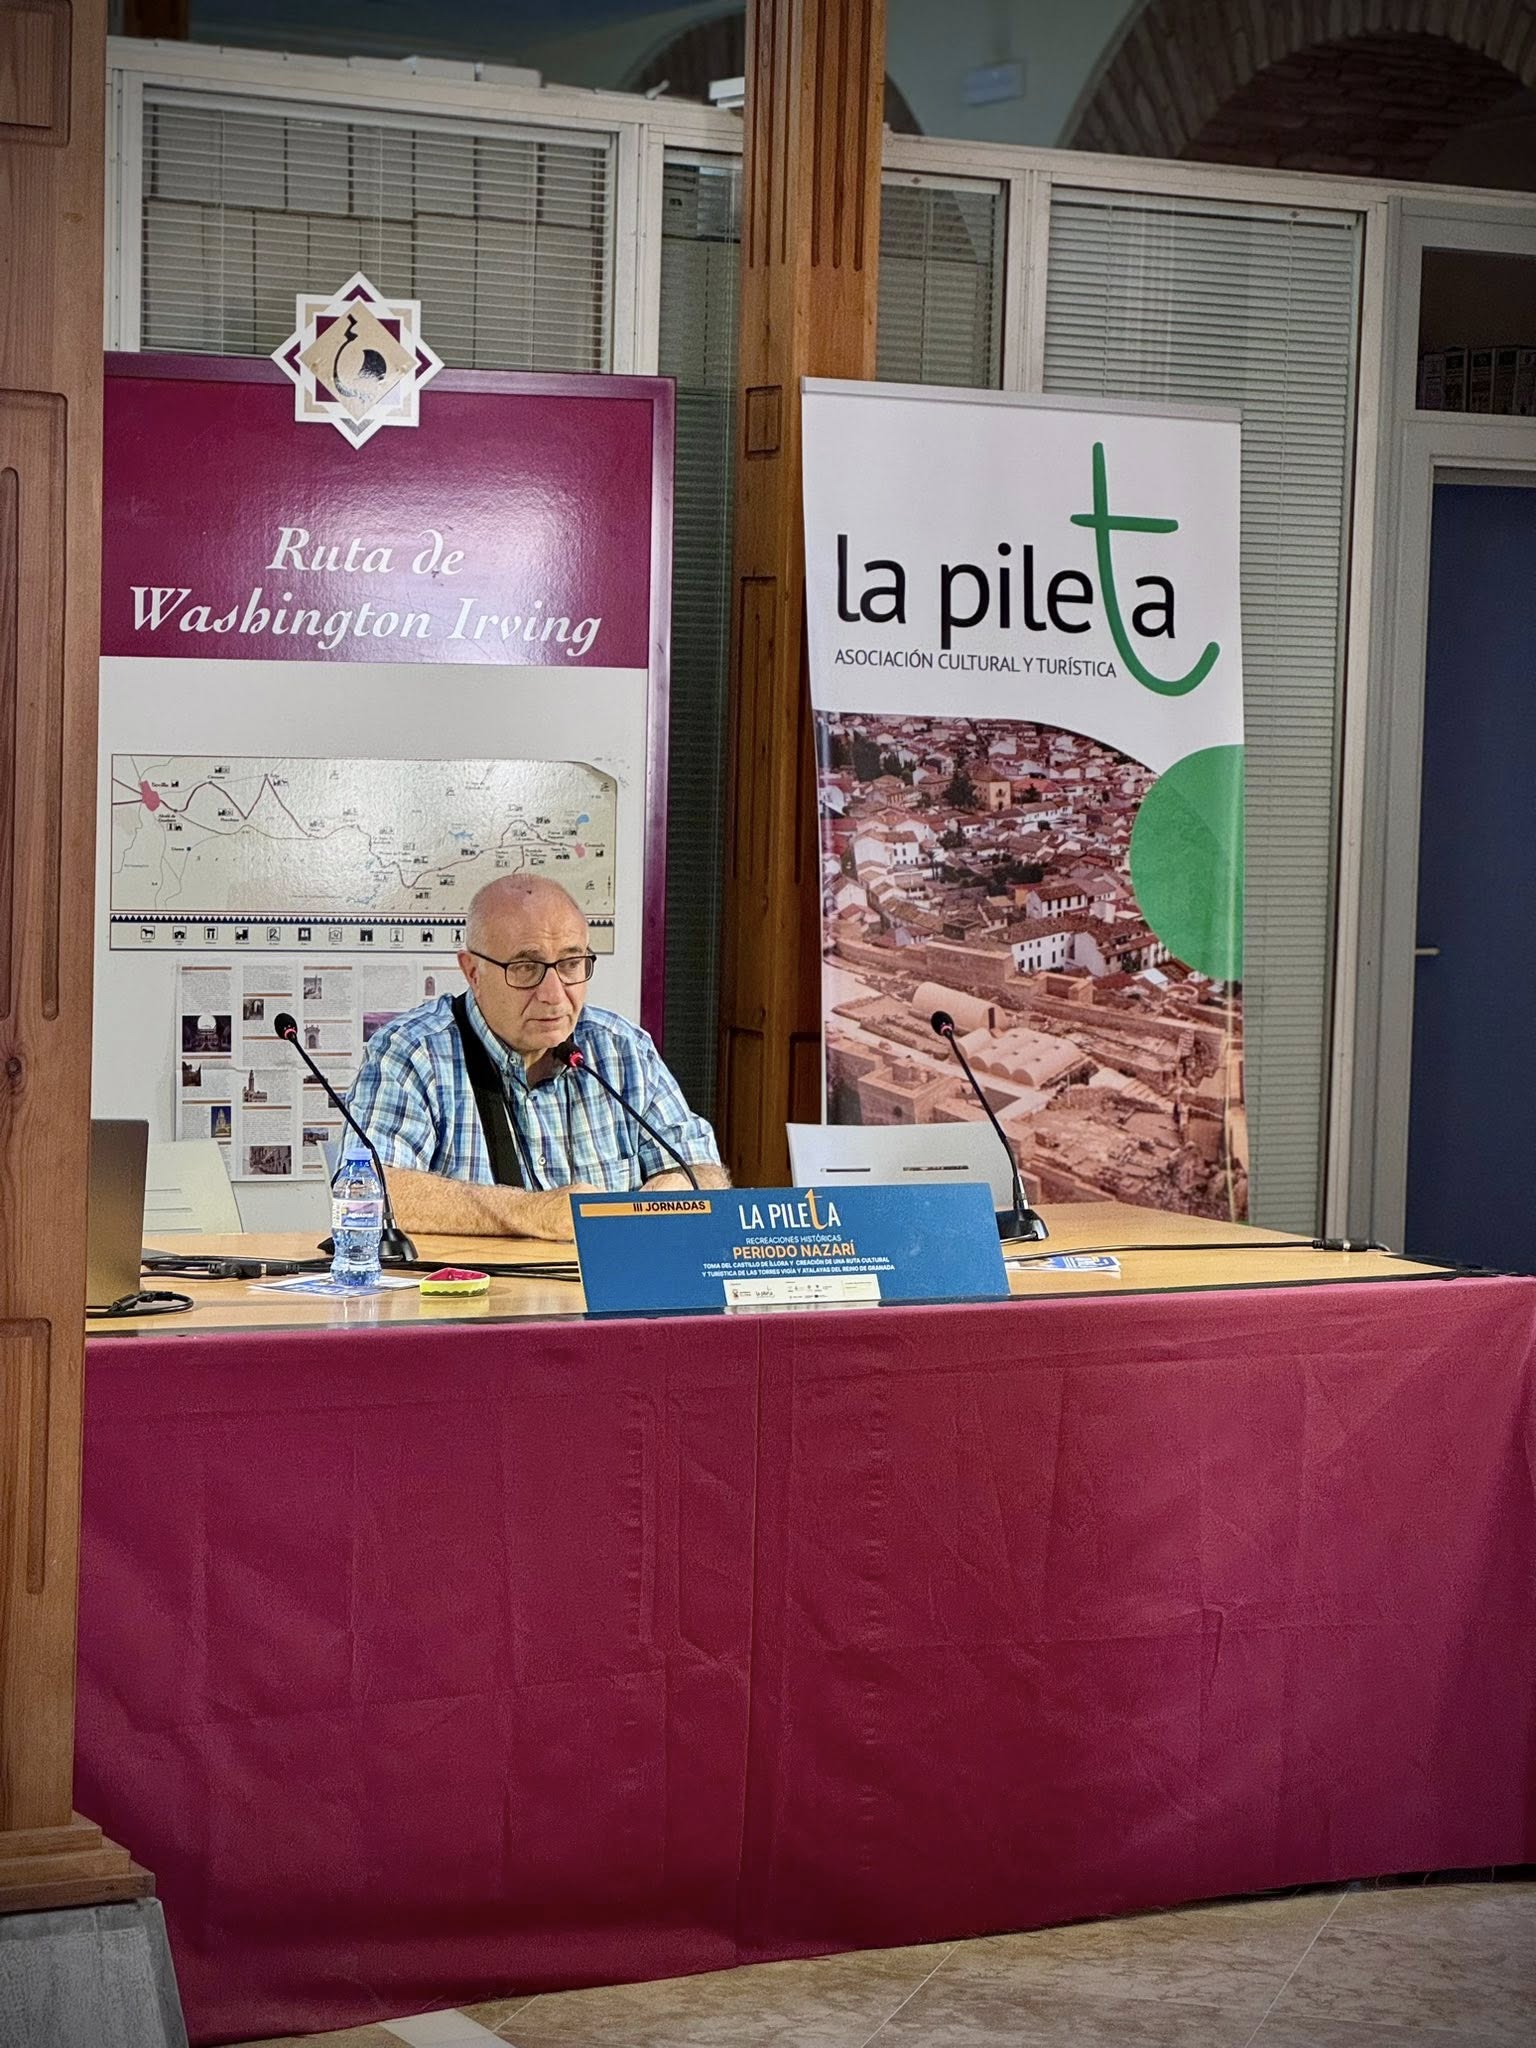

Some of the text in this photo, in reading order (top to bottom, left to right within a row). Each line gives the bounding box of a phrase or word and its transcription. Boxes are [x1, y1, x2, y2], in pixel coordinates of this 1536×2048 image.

[266, 526, 464, 576] Ruta de
[836, 441, 1220, 697] la pileta
[130, 586, 601, 657] Washington Irving
[834, 648, 1117, 678] ASOCIACIÓN CULTURAL Y TURÍSTICA
[632, 1200, 706, 1213] III JORNADAS
[738, 1204, 765, 1230] LA
[732, 1238, 856, 1260] PERIODO NAZARÍ
[745, 1233, 842, 1245] RECREACIONES HISTÓRICAS
[796, 1258, 824, 1266] CREACIÓN
